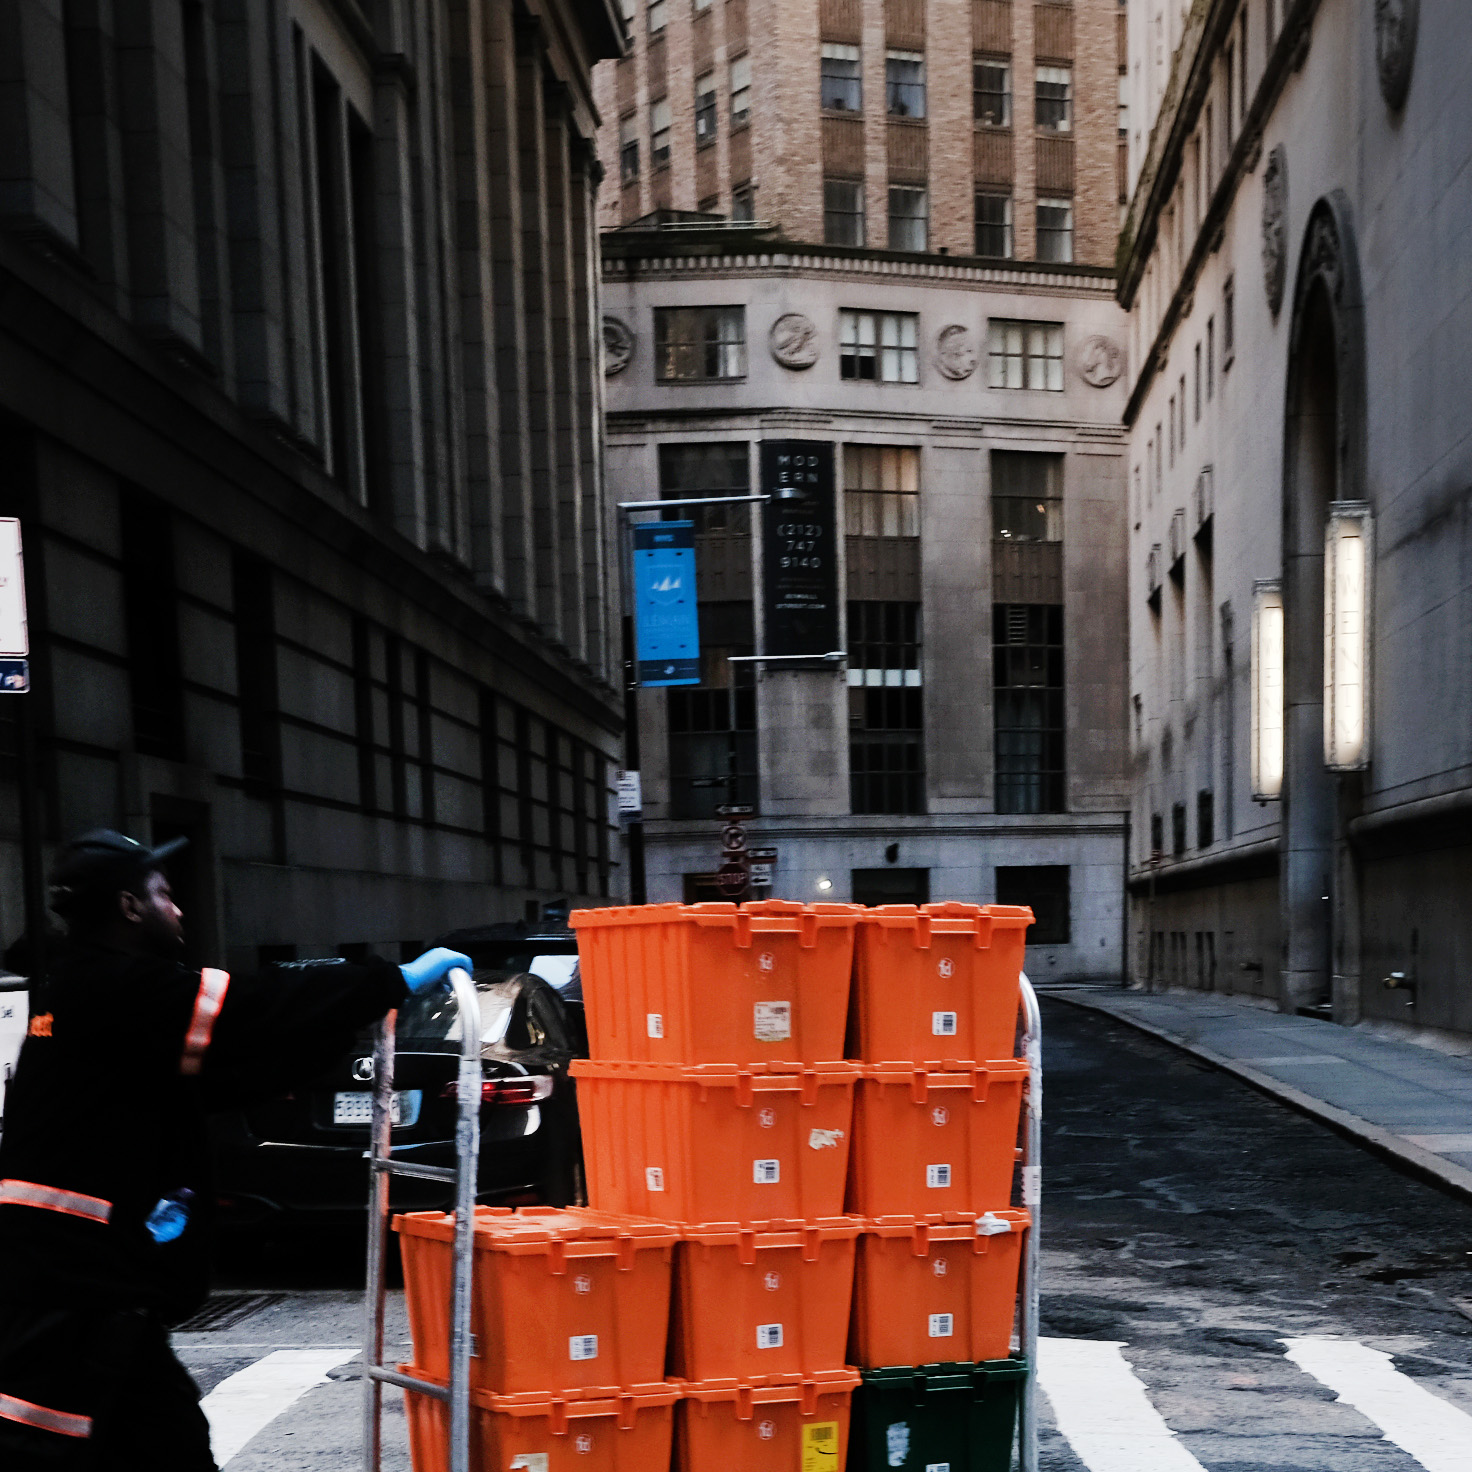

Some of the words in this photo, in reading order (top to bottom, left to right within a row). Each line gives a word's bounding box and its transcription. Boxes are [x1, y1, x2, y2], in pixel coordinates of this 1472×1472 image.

[777, 524, 823, 537] (212)
[785, 540, 816, 552] 747
[779, 556, 822, 568] 9140
